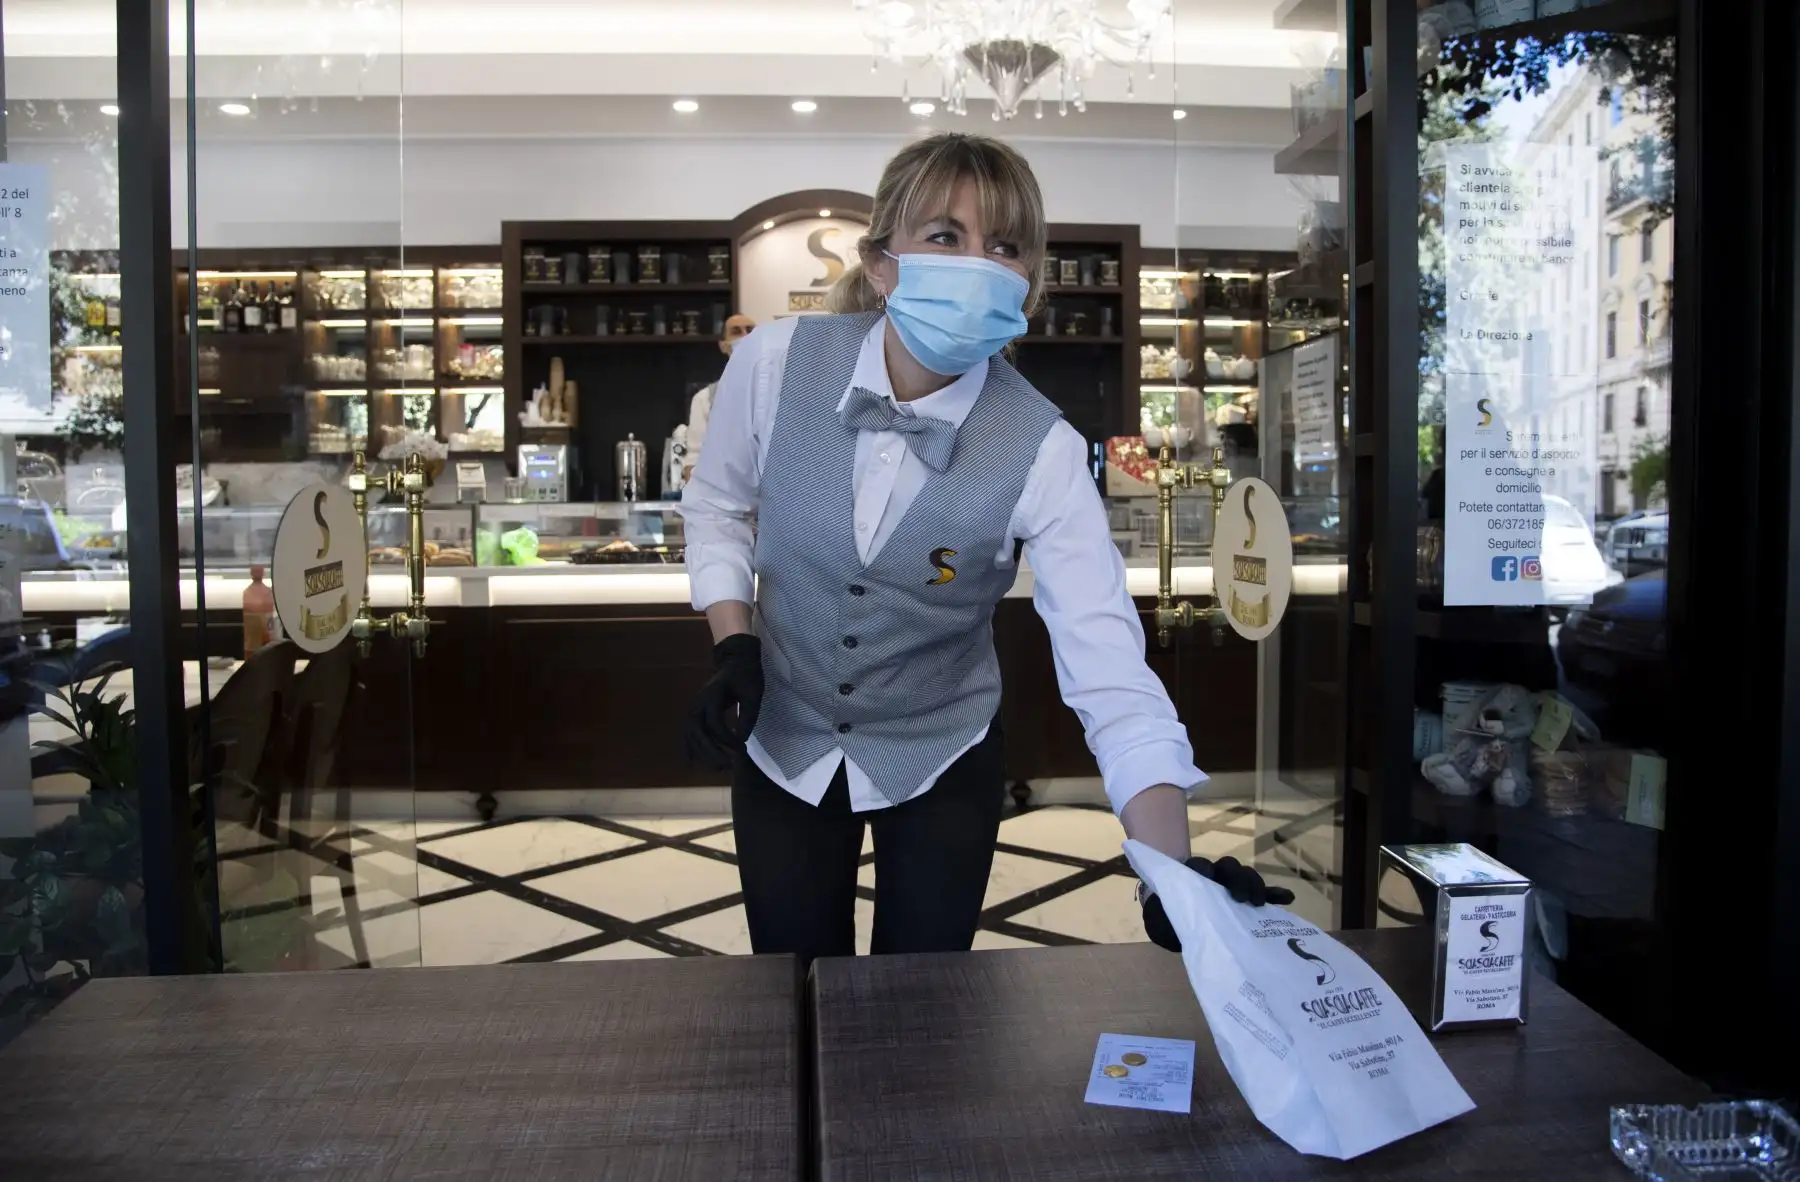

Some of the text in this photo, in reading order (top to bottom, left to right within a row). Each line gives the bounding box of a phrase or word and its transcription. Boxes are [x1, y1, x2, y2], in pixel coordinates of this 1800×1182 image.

[11, 188, 29, 200] del
[1459, 182, 1511, 194] clientela
[14, 207, 22, 219] 8
[10, 249, 17, 259] a
[1477, 327, 1534, 341] Direzioe
[1460, 449, 1479, 461] per
[1480, 447, 1486, 459] il
[1488, 448, 1529, 459] servizio
[1485, 467, 1556, 479] e consegne a
[1495, 482, 1542, 494] domicilio
[1459, 501, 1493, 513] Potete
[1487, 537, 1536, 551] Seguiteci
[1476, 1002, 1496, 1010] ROMA
[1367, 1066, 1391, 1080] ROMA
